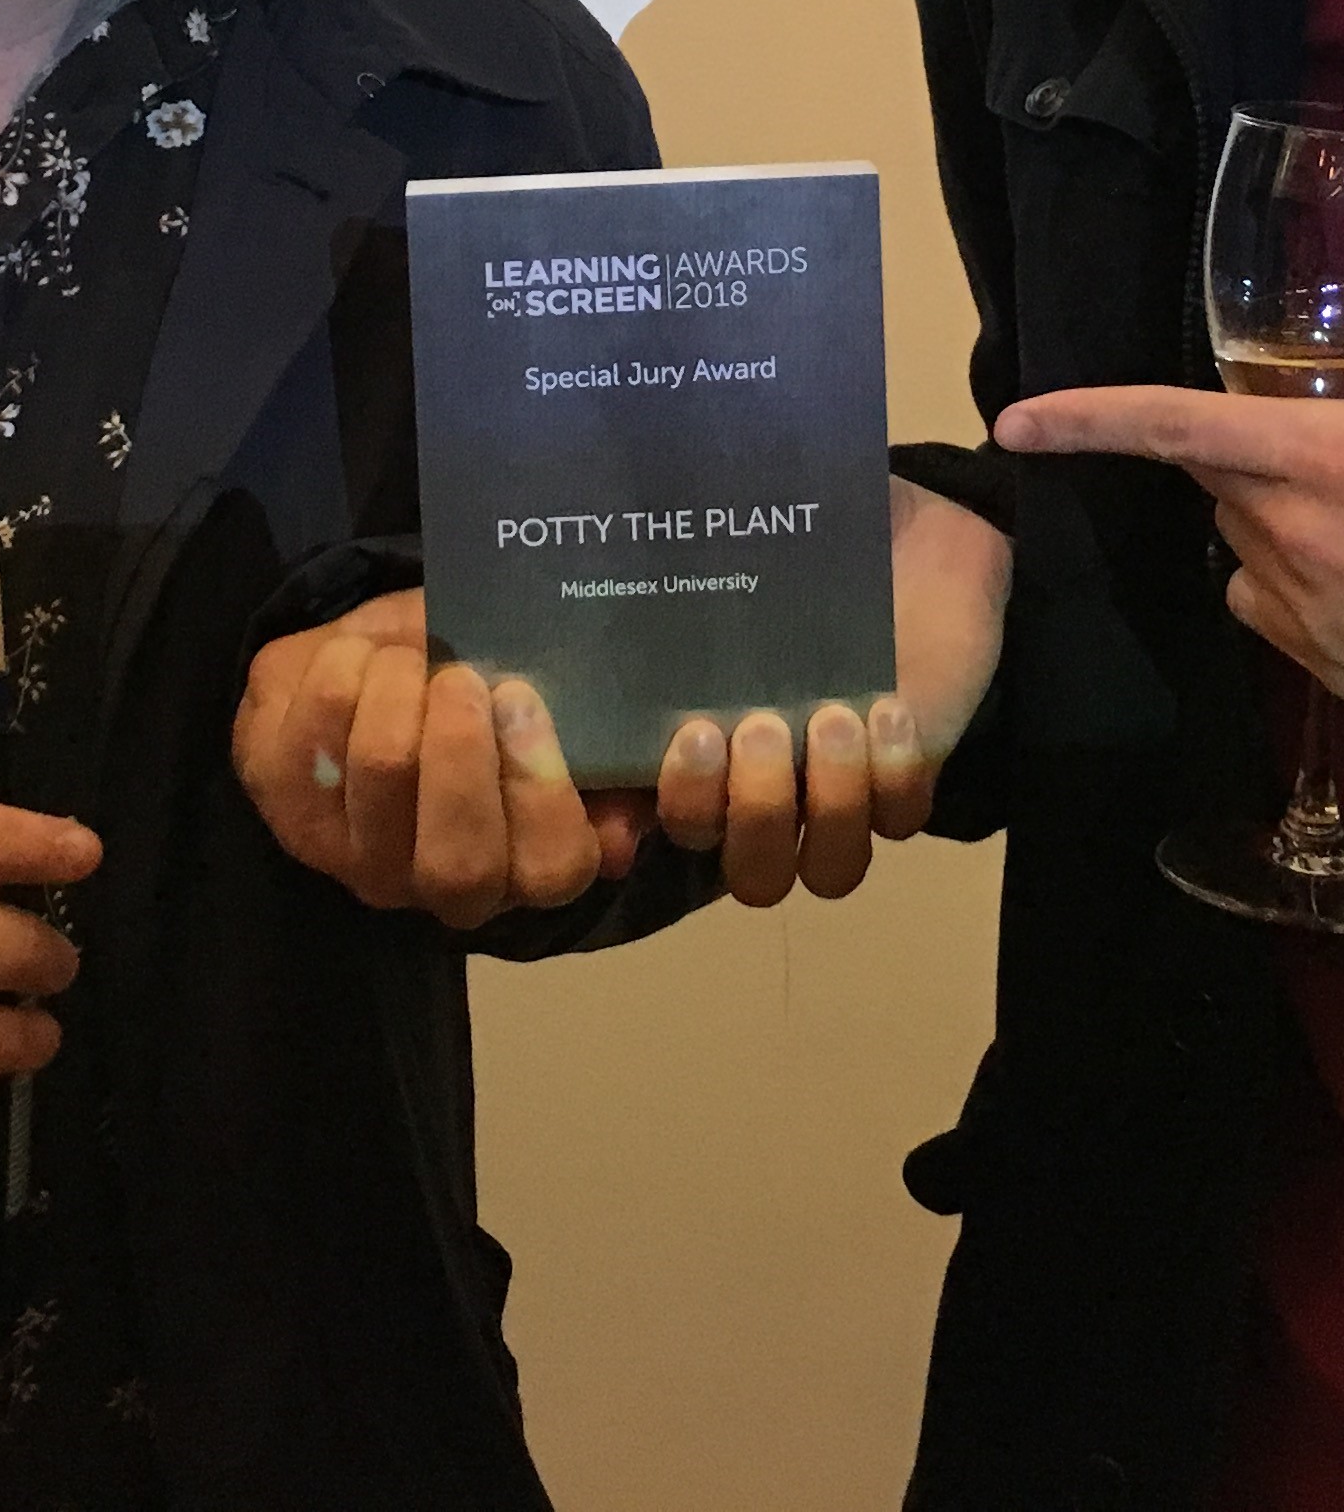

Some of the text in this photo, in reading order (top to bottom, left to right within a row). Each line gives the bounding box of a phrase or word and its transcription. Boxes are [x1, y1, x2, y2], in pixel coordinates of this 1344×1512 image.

[484, 253, 661, 288] LEARNING
[674, 246, 808, 279] AWARDS
[491, 297, 516, 312] ON
[524, 284, 662, 317] SCREEN
[674, 280, 748, 310] 2018
[524, 355, 777, 396] Special Jury Award
[497, 503, 820, 549] POTTY THE PLANT
[560, 572, 760, 600] Middlesex University
